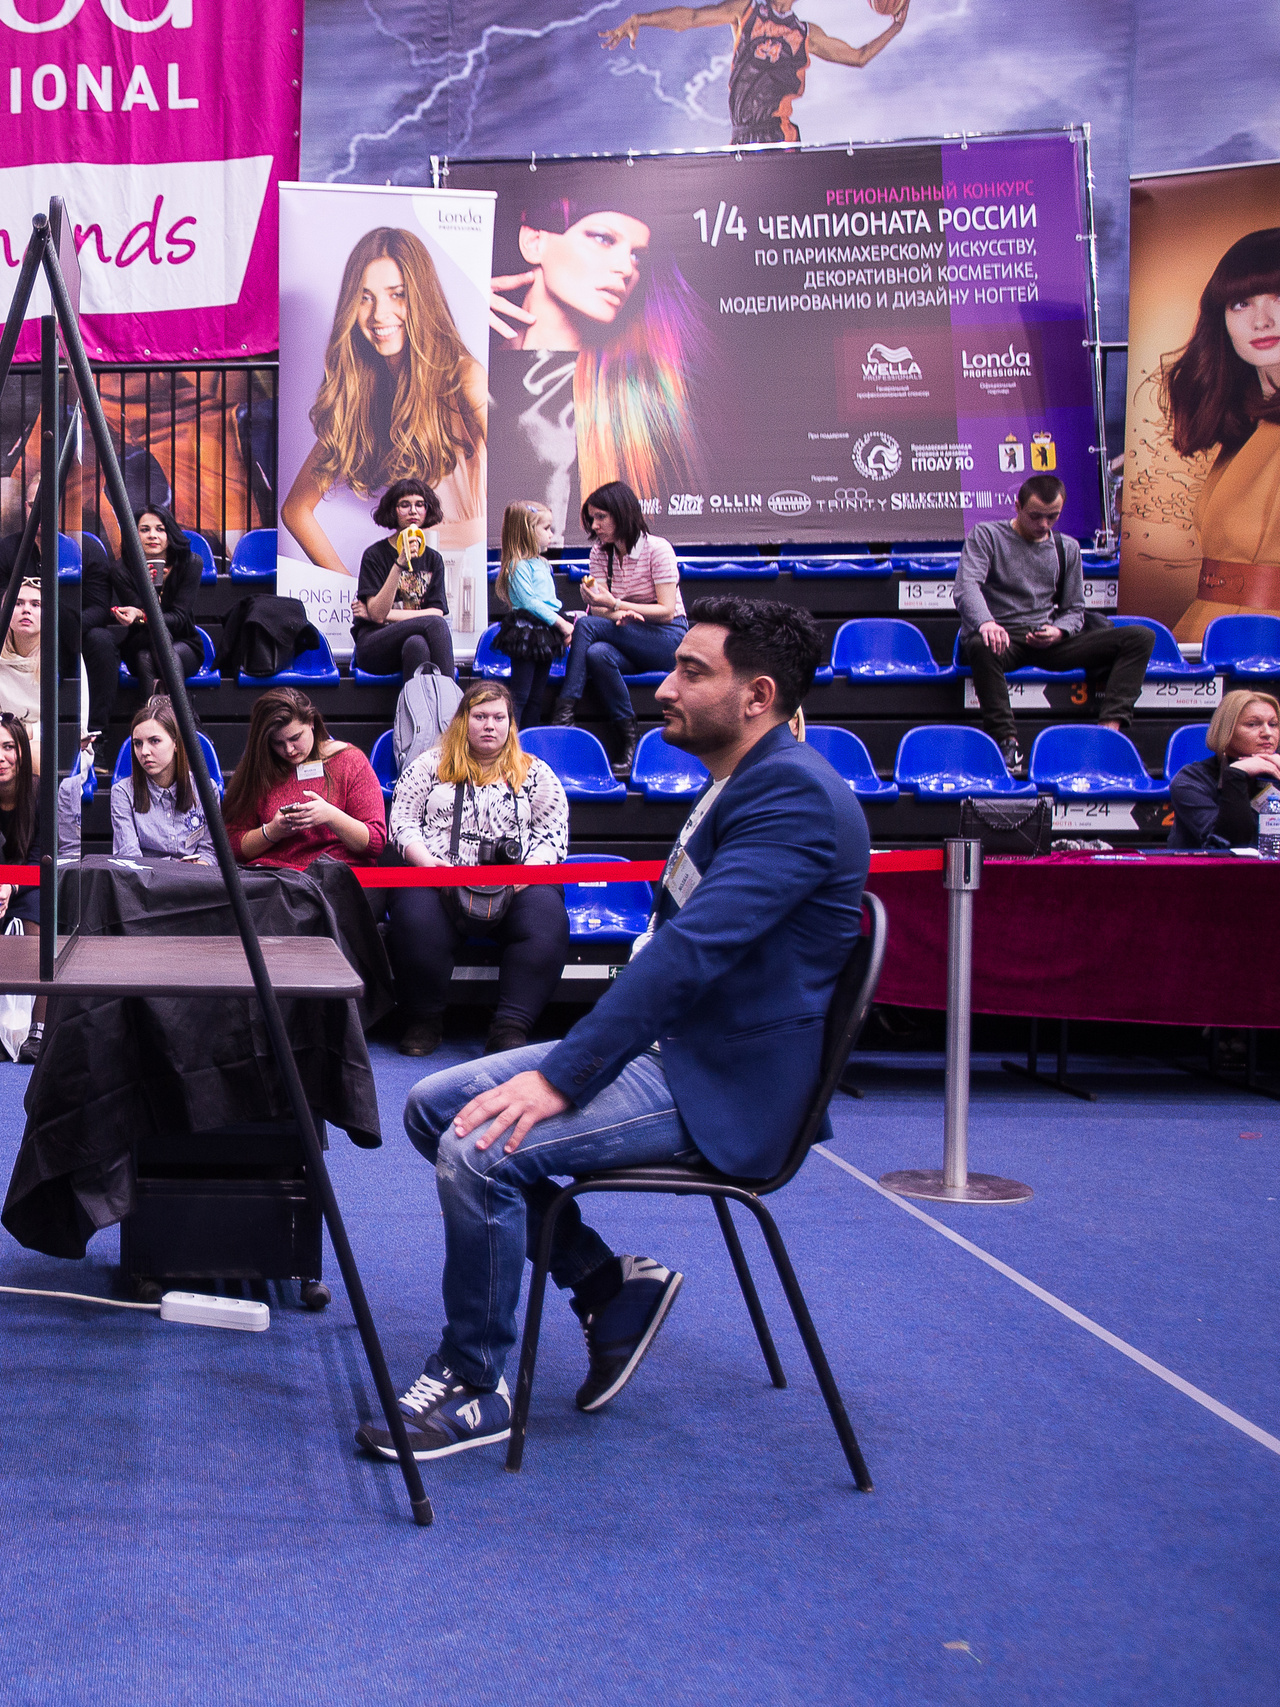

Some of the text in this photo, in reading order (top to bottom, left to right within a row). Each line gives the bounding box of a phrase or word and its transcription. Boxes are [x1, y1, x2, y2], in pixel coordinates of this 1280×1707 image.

[826, 180, 1035, 206] РЕГИОНАЛЬНЫЙ КОНКУРС
[438, 208, 482, 224] Londa
[692, 200, 1038, 248] 1/4 ЧЕМПИОНАТА РОССИИ
[754, 238, 1037, 266] ПО ПАРИКМАХЕРСКОМУ ИСКУССТВУ,
[803, 262, 1038, 290] ДЕКОРАТИВНОЙ КОСМЕТИКЕ,
[720, 282, 1039, 316] МОДЕЛИРОВАНИЮ И ДИЗАЙНУ НОГТЕЙ
[962, 343, 1031, 369] Londa
[861, 362, 922, 376] WELLA
[963, 368, 1032, 379] PROFESSIONAL
[911, 456, 974, 471] ГПОАУ ЯО
[710, 493, 762, 508] OLLIN
[891, 491, 973, 511] SELECTIVE
[1082, 583, 1117, 597] 8-3
[318, 609, 352, 623] CAR
[1070, 682, 1088, 705] 3
